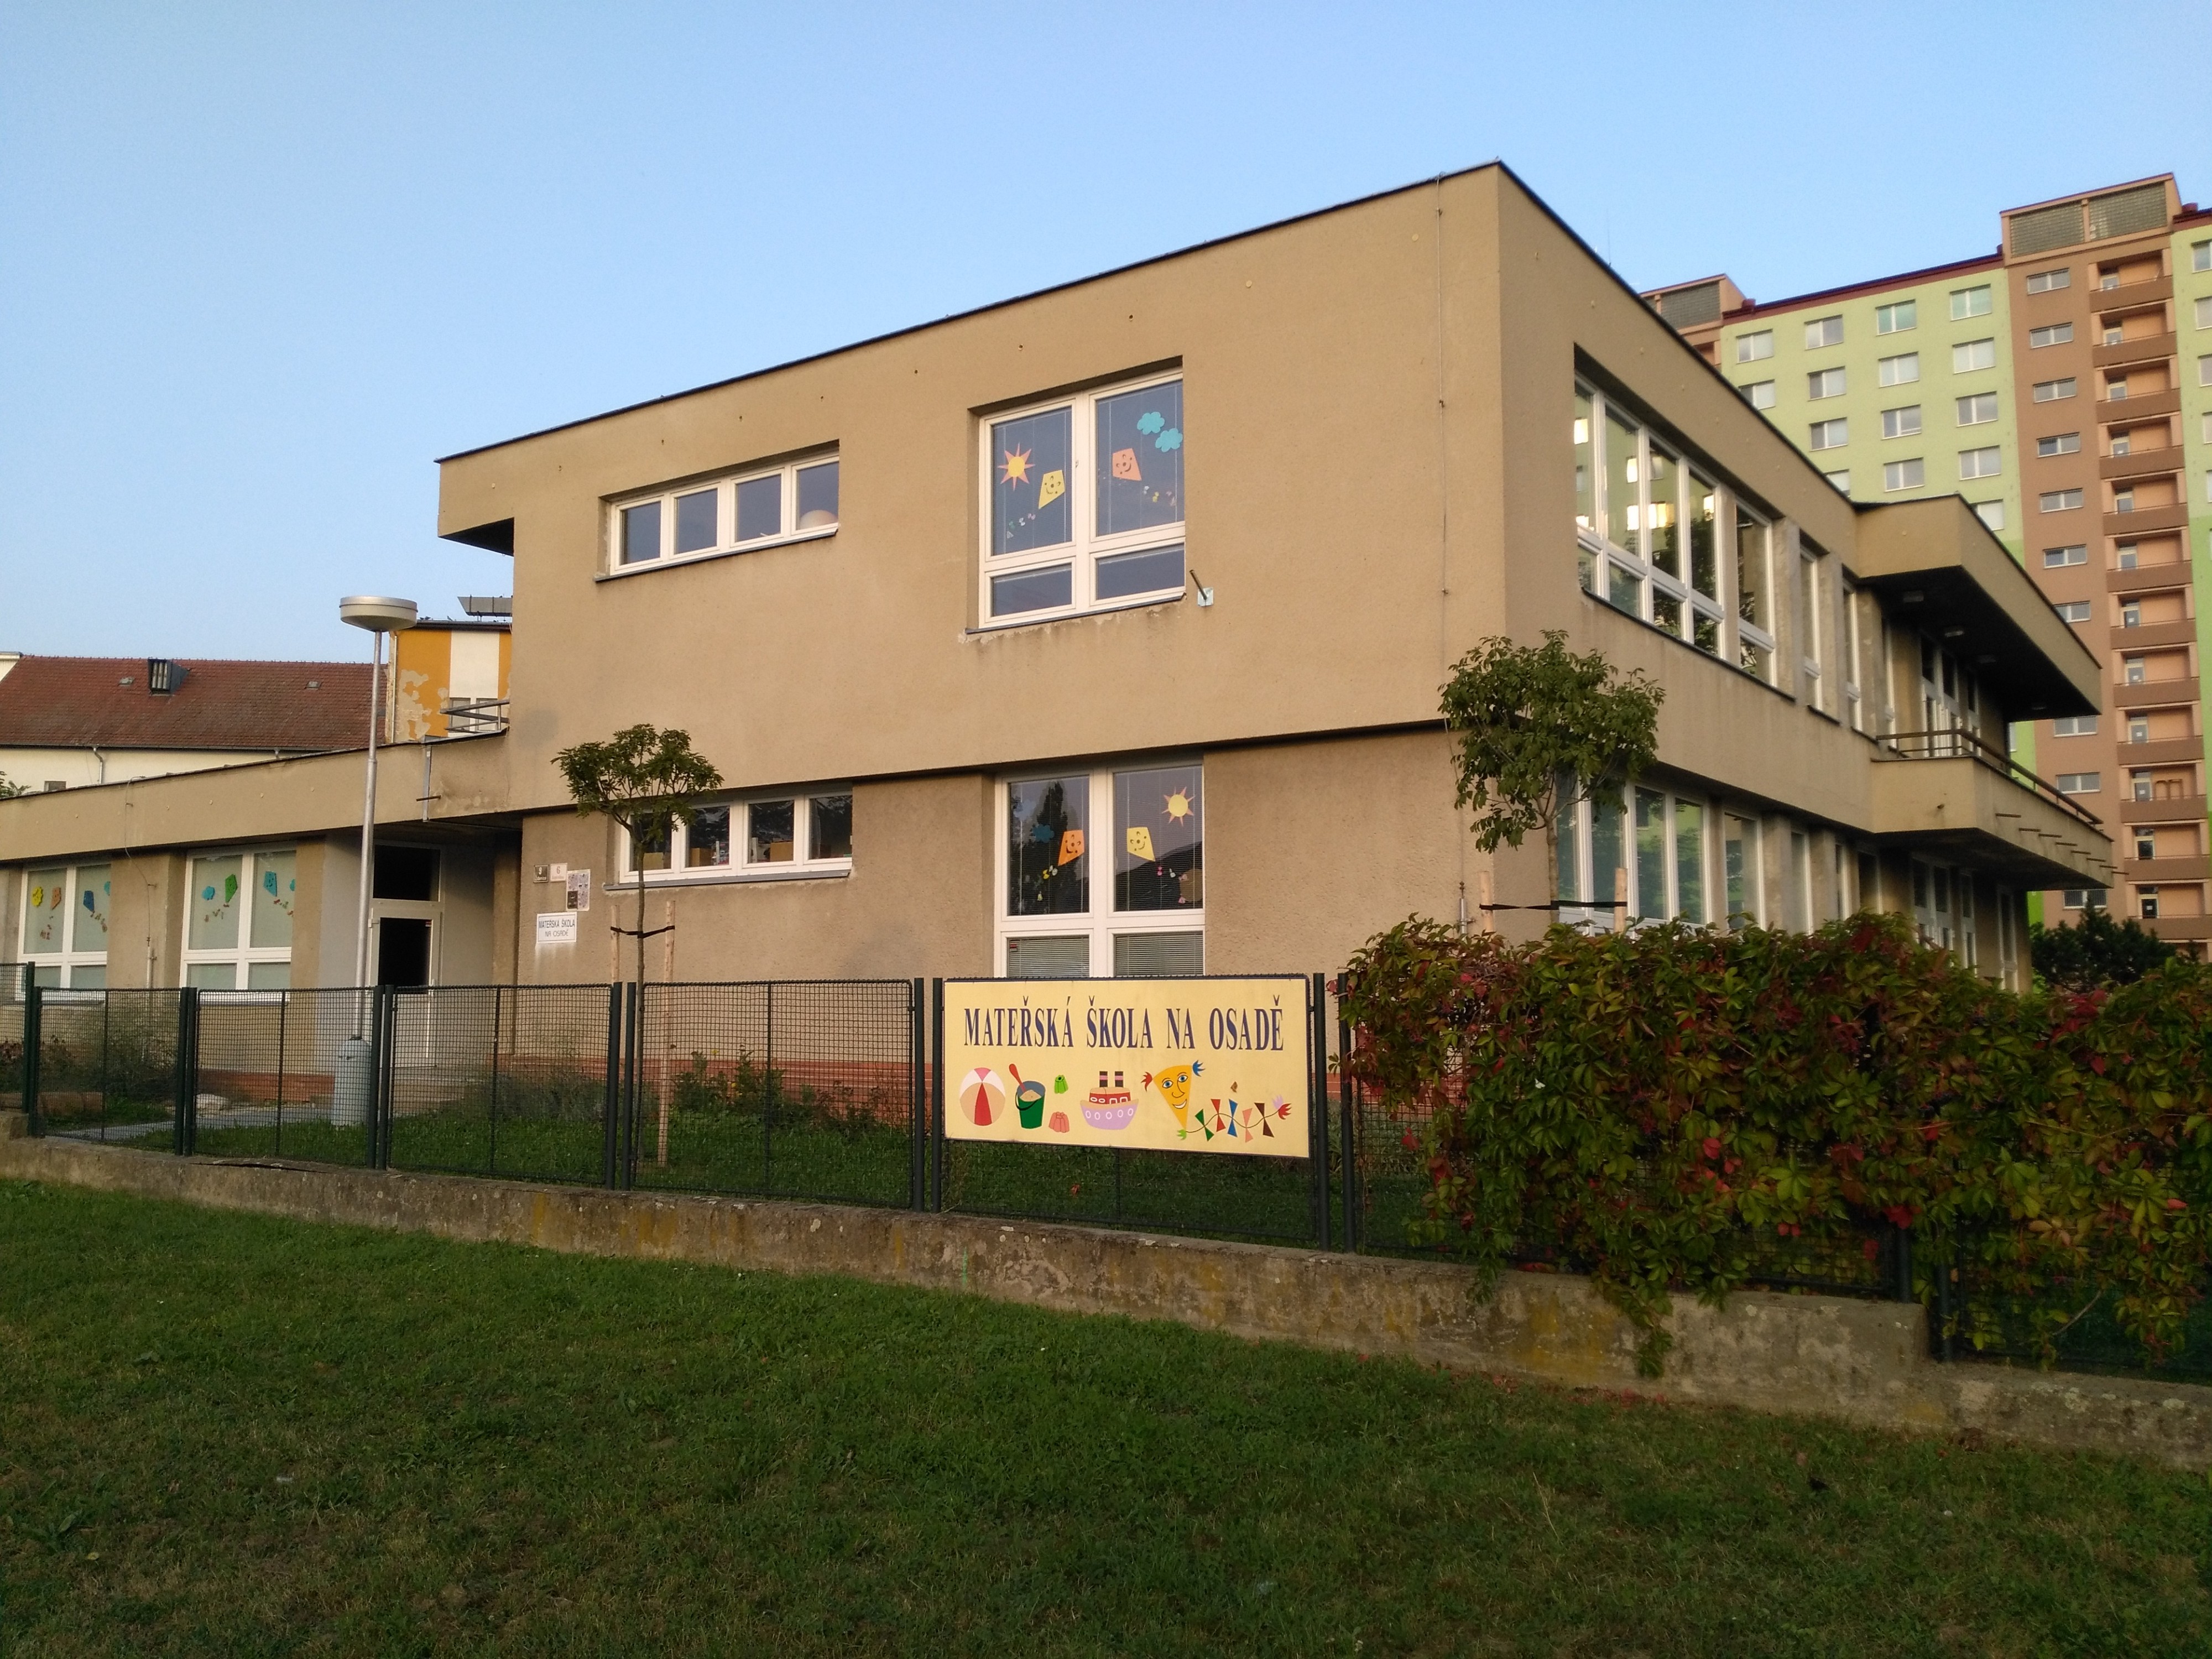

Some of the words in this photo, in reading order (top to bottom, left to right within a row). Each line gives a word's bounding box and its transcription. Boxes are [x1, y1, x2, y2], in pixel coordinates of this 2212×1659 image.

[539, 867, 542, 875] 9
[556, 865, 560, 874] 6
[539, 919, 560, 928] MATEŘSKÁ
[561, 918, 575, 927] ŠKOLA
[553, 928, 568, 937] OSADĚ
[964, 995, 1074, 1047] MATEŘSKÁ
[1087, 995, 1154, 1048] ŠKOLA
[1166, 1008, 1196, 1050] NA
[1209, 994, 1284, 1051] OSADĚ
